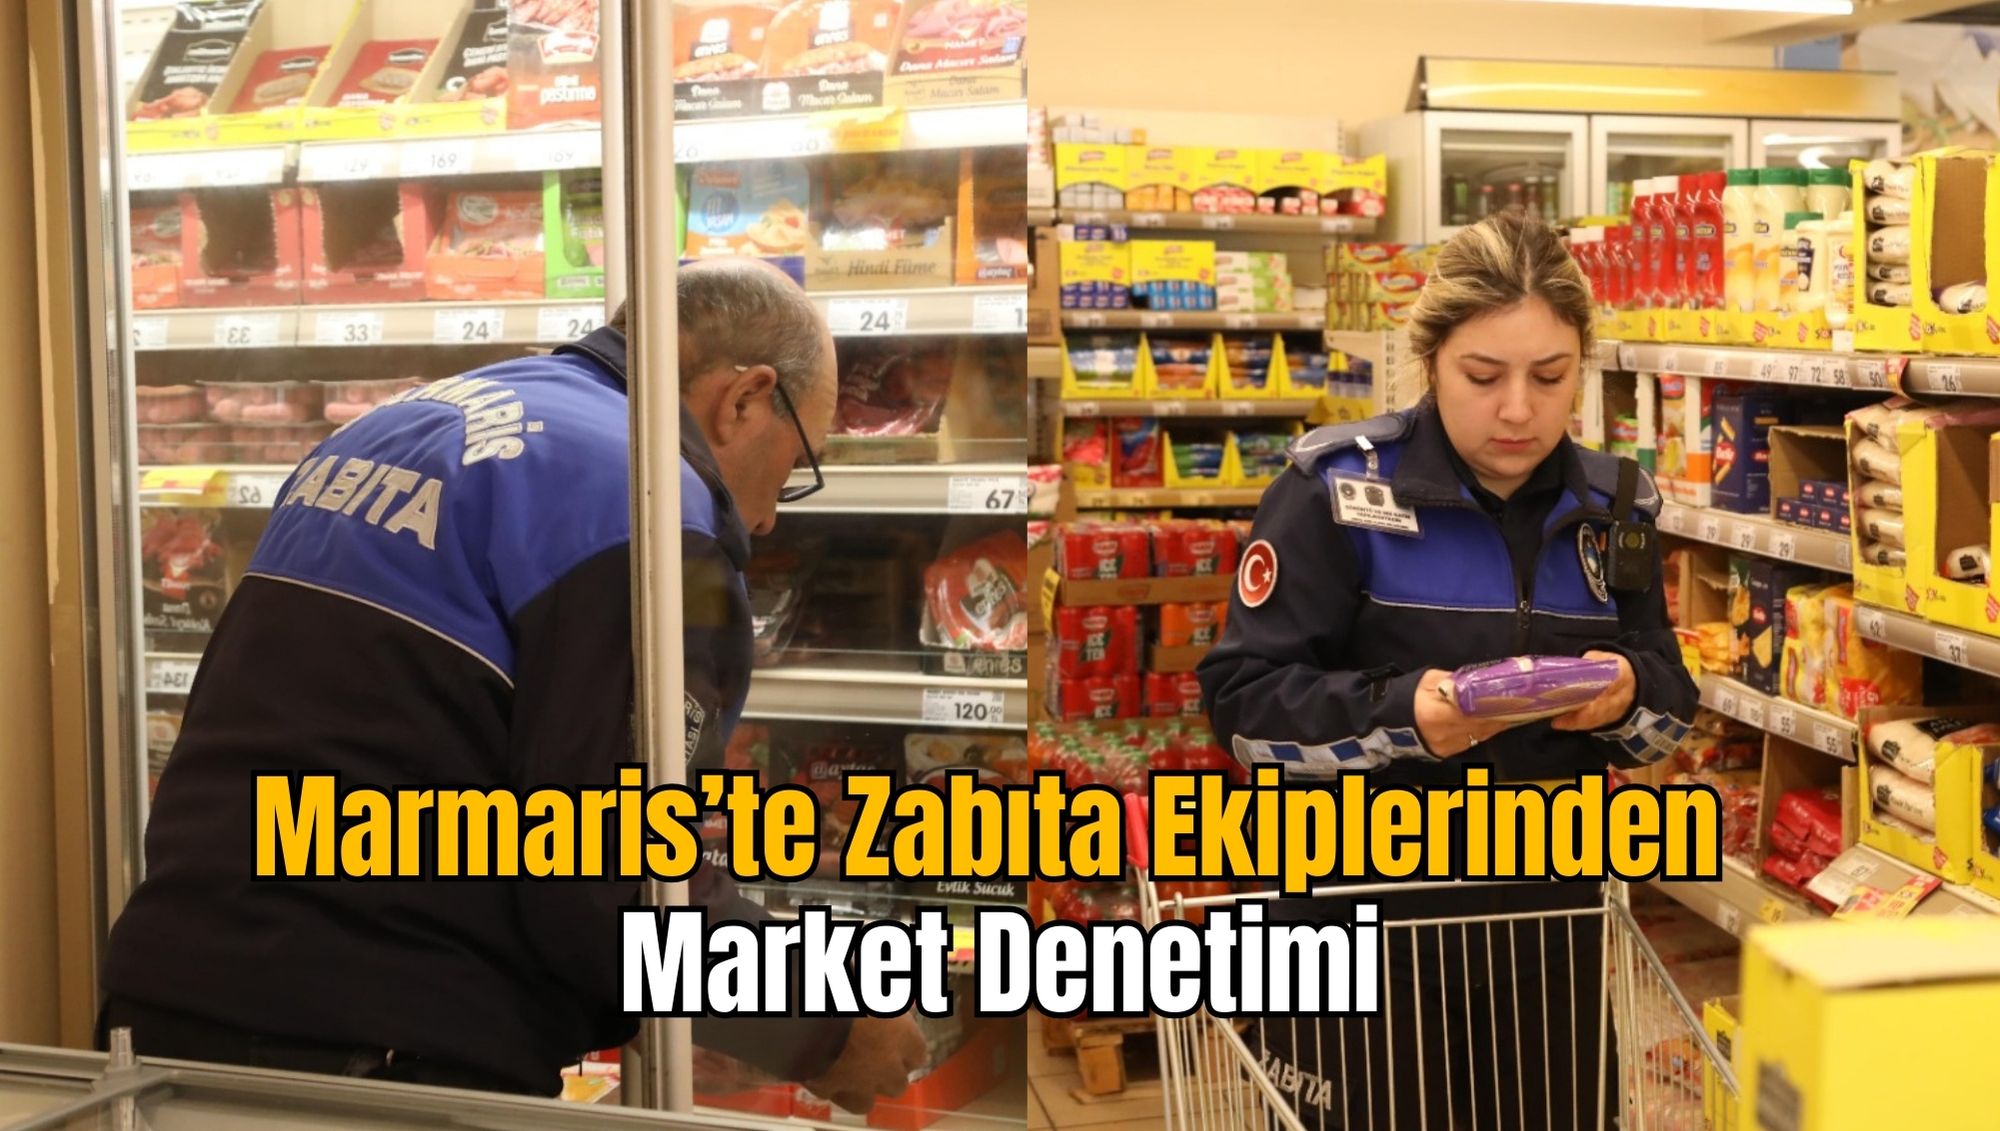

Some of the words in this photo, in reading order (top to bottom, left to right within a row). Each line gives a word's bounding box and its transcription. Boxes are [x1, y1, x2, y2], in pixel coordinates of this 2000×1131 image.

[848, 260, 889, 277] Hindi
[567, 318, 594, 337] 24
[859, 310, 891, 332] 24
[344, 323, 370, 343] 33
[462, 320, 490, 342] 24
[1788, 366, 1799, 381] 97
[1811, 366, 1821, 382] 72
[1833, 370, 1845, 385] 58
[1941, 374, 1957, 392] 26
[282, 454, 444, 551] ABITA
[984, 488, 1016, 510] 67
[1705, 524, 1717, 541] 29
[1741, 533, 1751, 548] 29
[1778, 542, 1790, 558] 29
[954, 702, 988, 721] 120
[972, 880, 1016, 896] Sucuk
